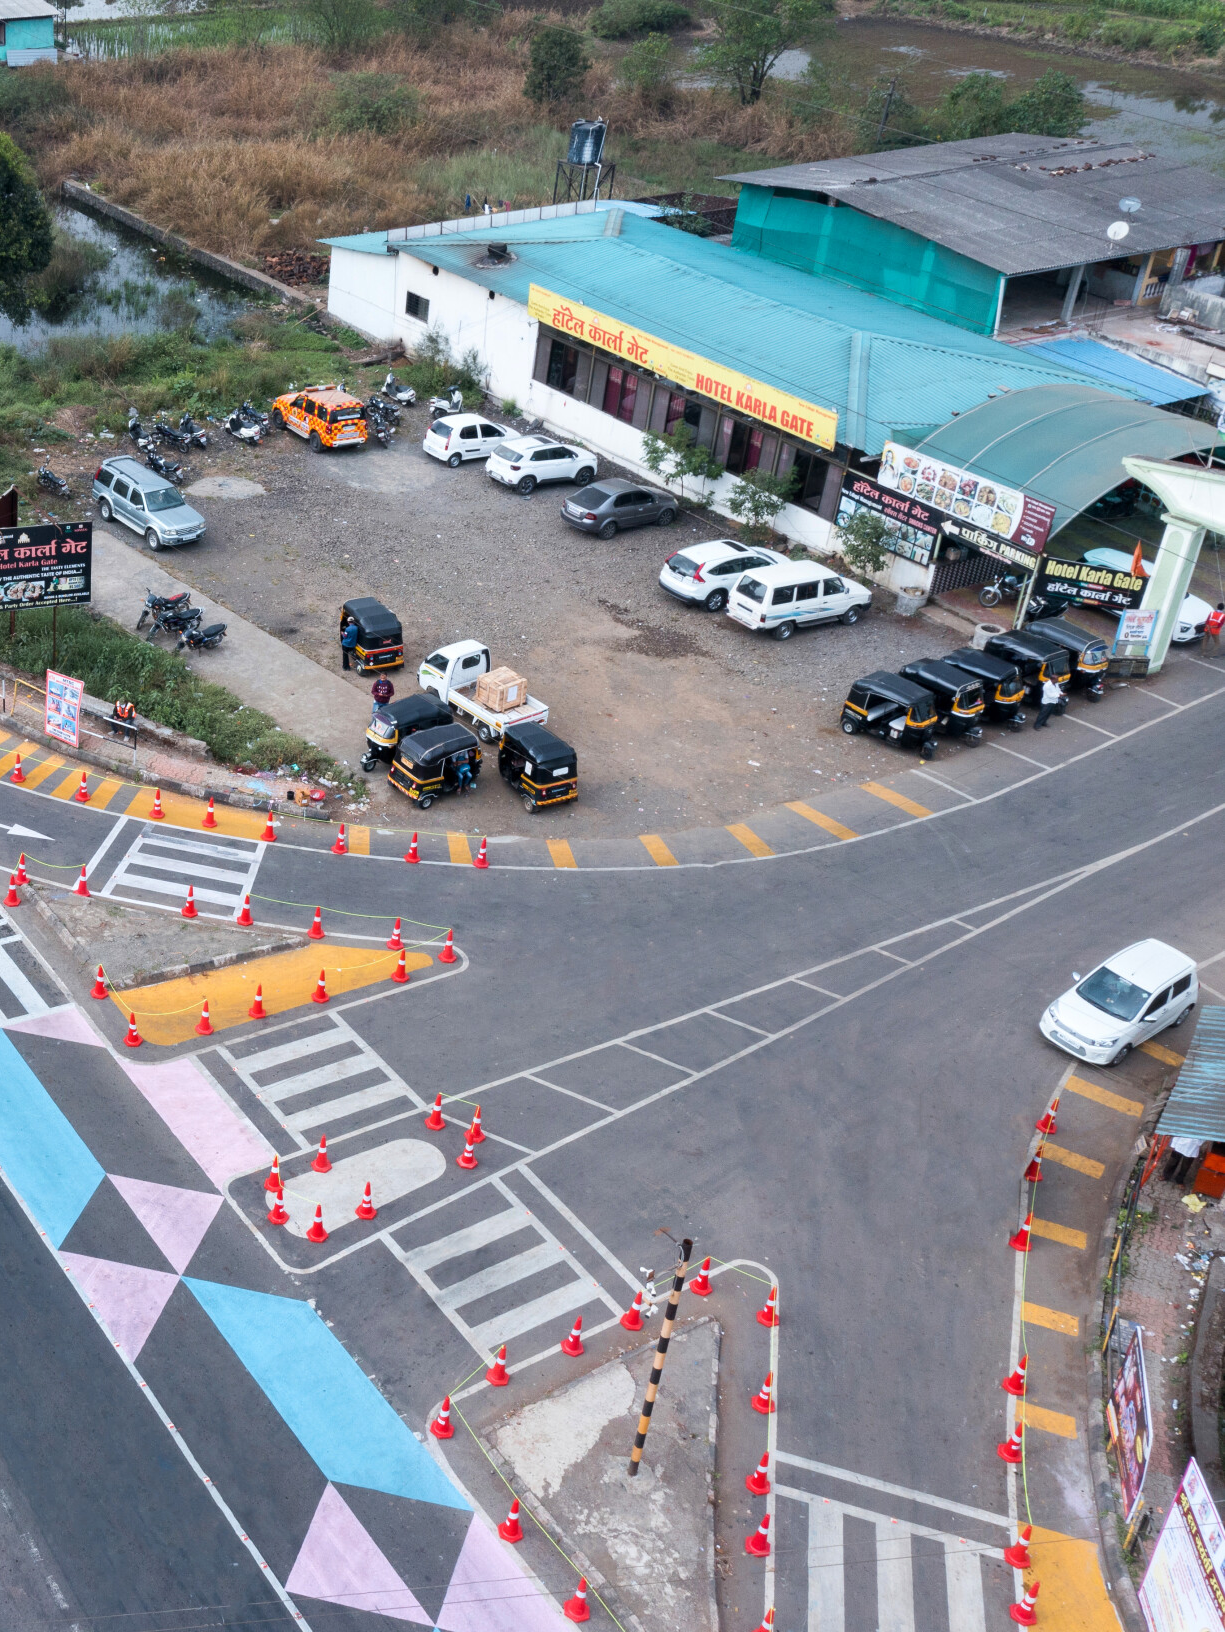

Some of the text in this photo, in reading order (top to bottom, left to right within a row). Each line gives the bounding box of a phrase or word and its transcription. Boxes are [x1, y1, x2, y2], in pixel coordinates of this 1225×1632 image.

[552, 304, 585, 336] हॉटेल
[588, 323, 624, 353] कार्ला
[627, 335, 649, 364] गेट
[695, 373, 814, 439] HOTEL KARLA GATE
[852, 481, 930, 521] हॉटेल कार्ला गेट
[14, 539, 57, 559] कार्ला
[61, 538, 87, 554] गेट
[998, 543, 1036, 568] PARKING
[13, 573, 40, 581] AUTHENTIC
[1045, 560, 1143, 591] Hotel Karla Gate
[35, 599, 58, 607] Accepted
[1046, 582, 1077, 596] हॉटेल
[1079, 588, 1112, 601] कार्ला
[1112, 593, 1132, 605] गेट
